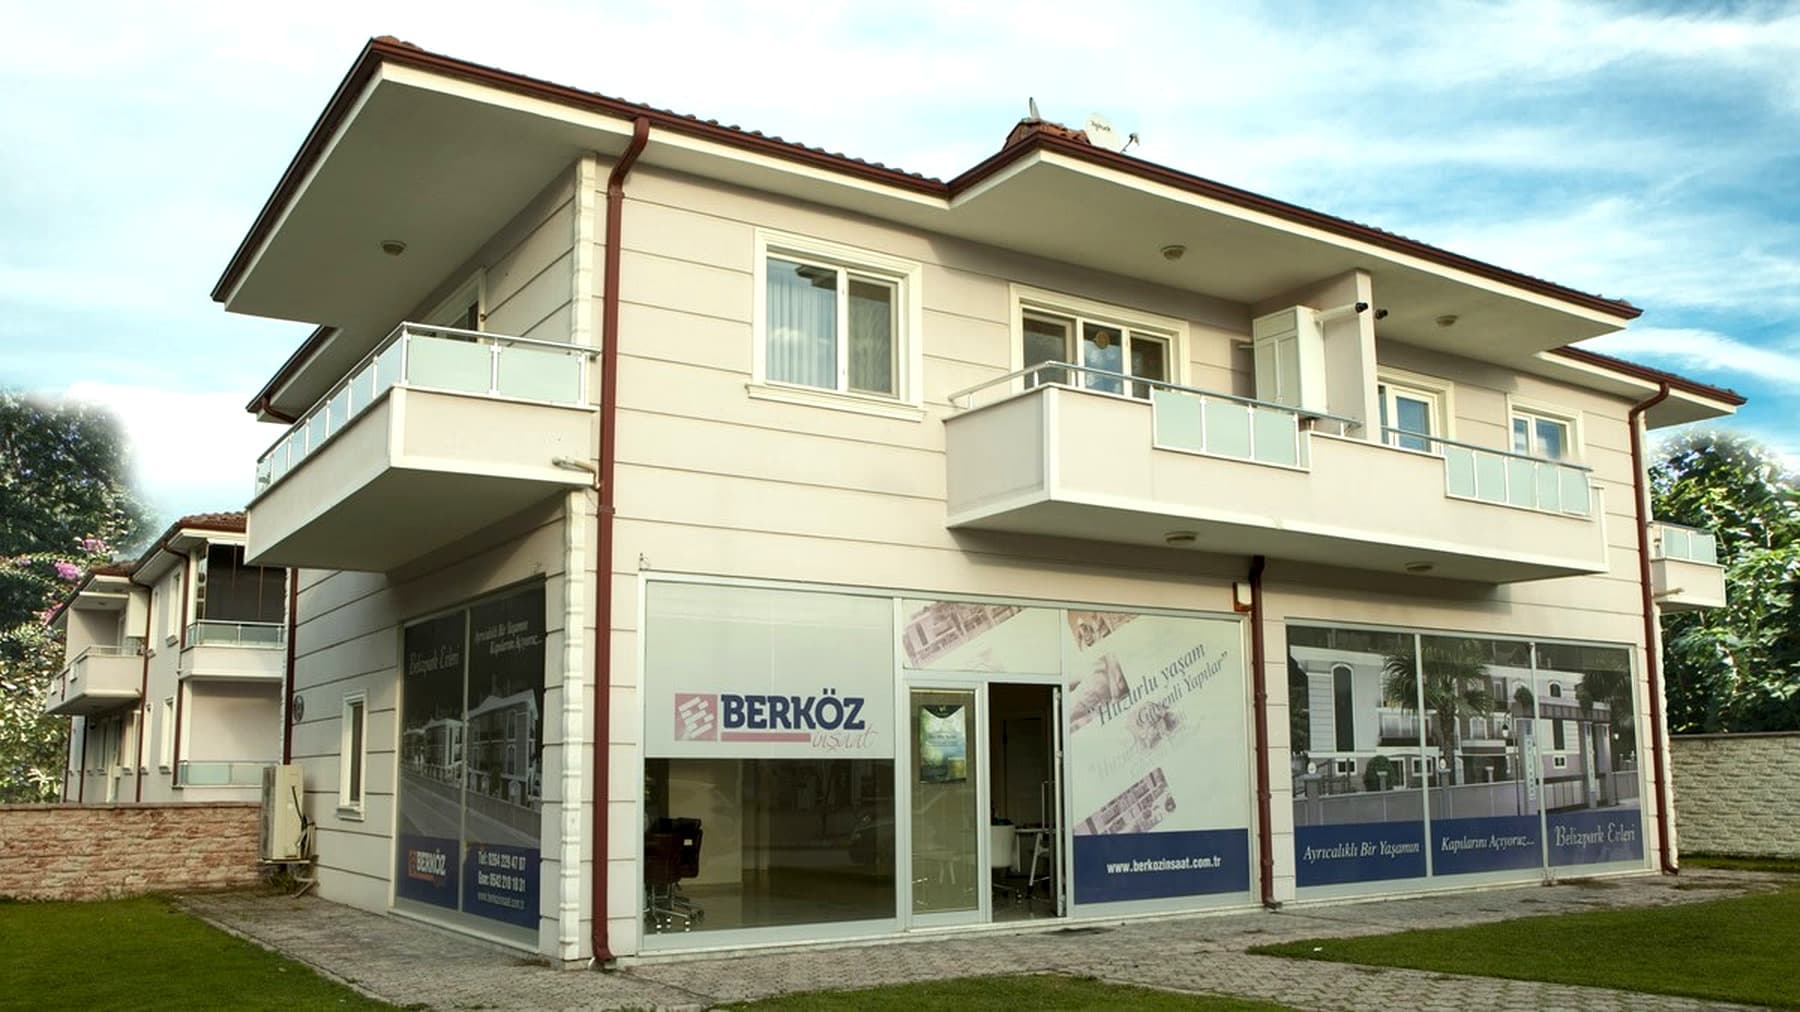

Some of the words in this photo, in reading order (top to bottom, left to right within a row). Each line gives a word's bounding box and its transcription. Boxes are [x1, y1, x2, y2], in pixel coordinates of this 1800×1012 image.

[1161, 643, 1206, 689] yaşam
[721, 688, 866, 731] BERKÖZ
[416, 848, 446, 876] BERKÖZ
[1106, 855, 1222, 874] www.berkozinsaat.com.tr
[1303, 842, 1358, 864] Ayrıcalıklı
[1360, 841, 1377, 857] Bir
[1379, 840, 1420, 858] Yaşamın
